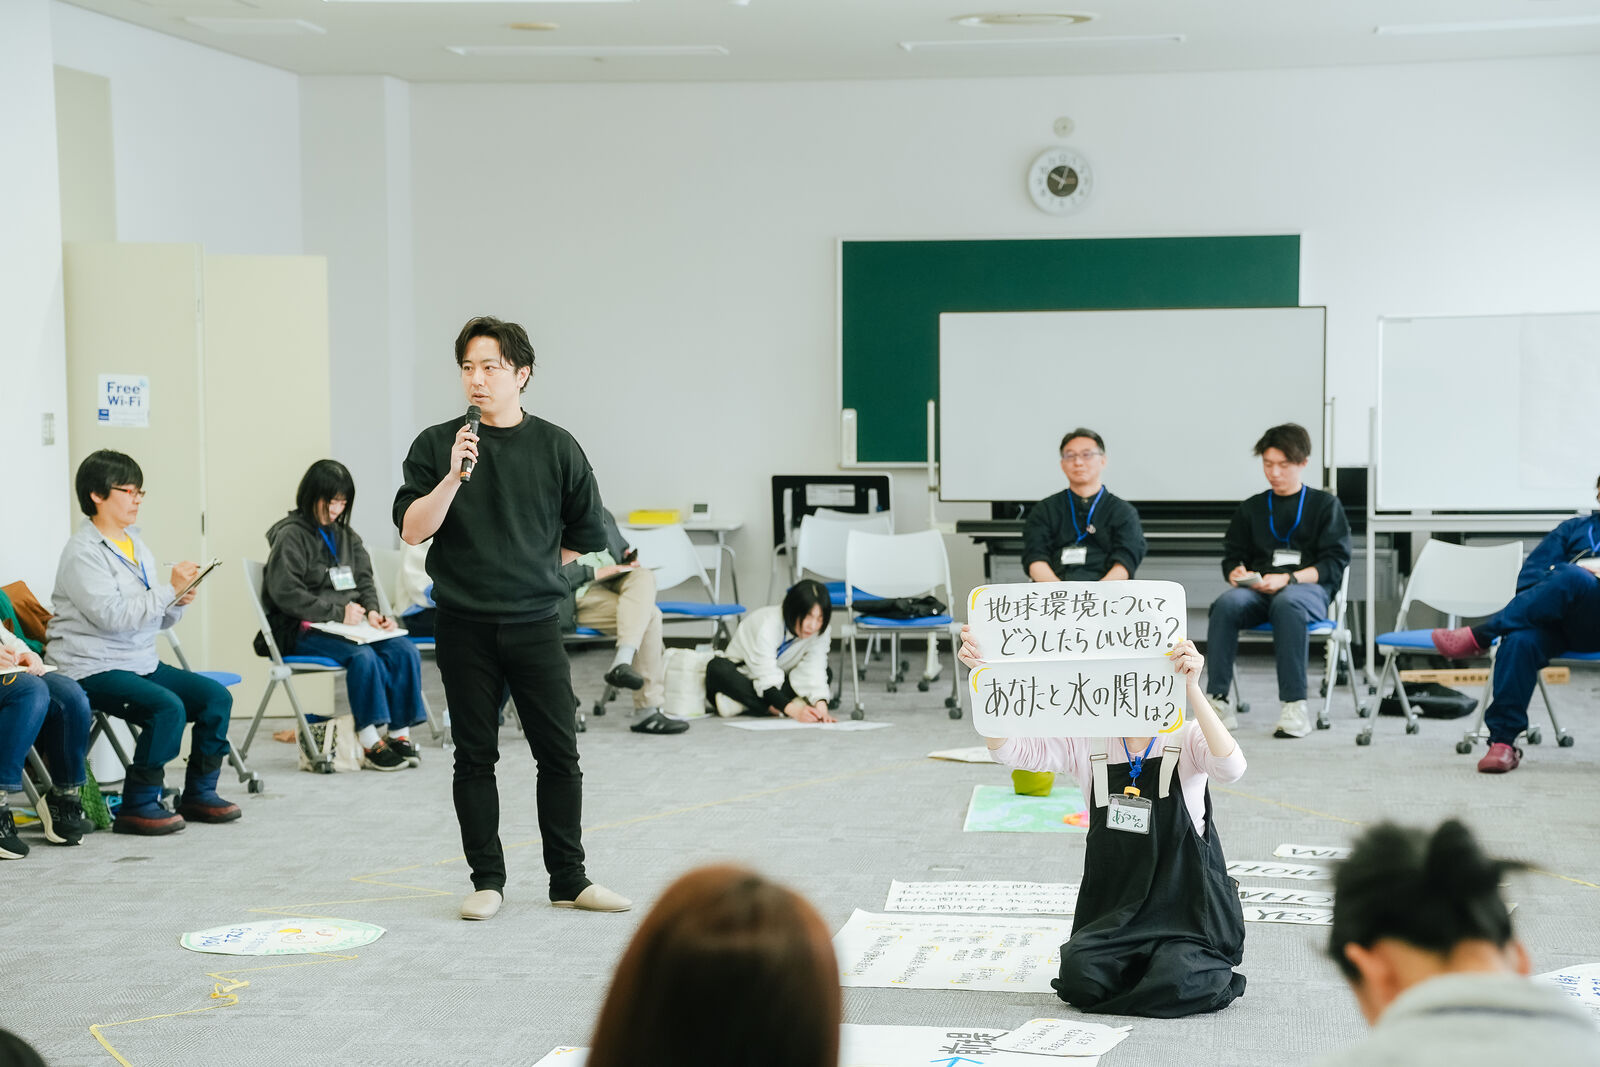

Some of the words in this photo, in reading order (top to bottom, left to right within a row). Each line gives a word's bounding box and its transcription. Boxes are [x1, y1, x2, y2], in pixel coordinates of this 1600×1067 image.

[107, 381, 141, 394] Free
[107, 395, 141, 407] Wi-Fi
[984, 590, 1167, 622] 地球環境について
